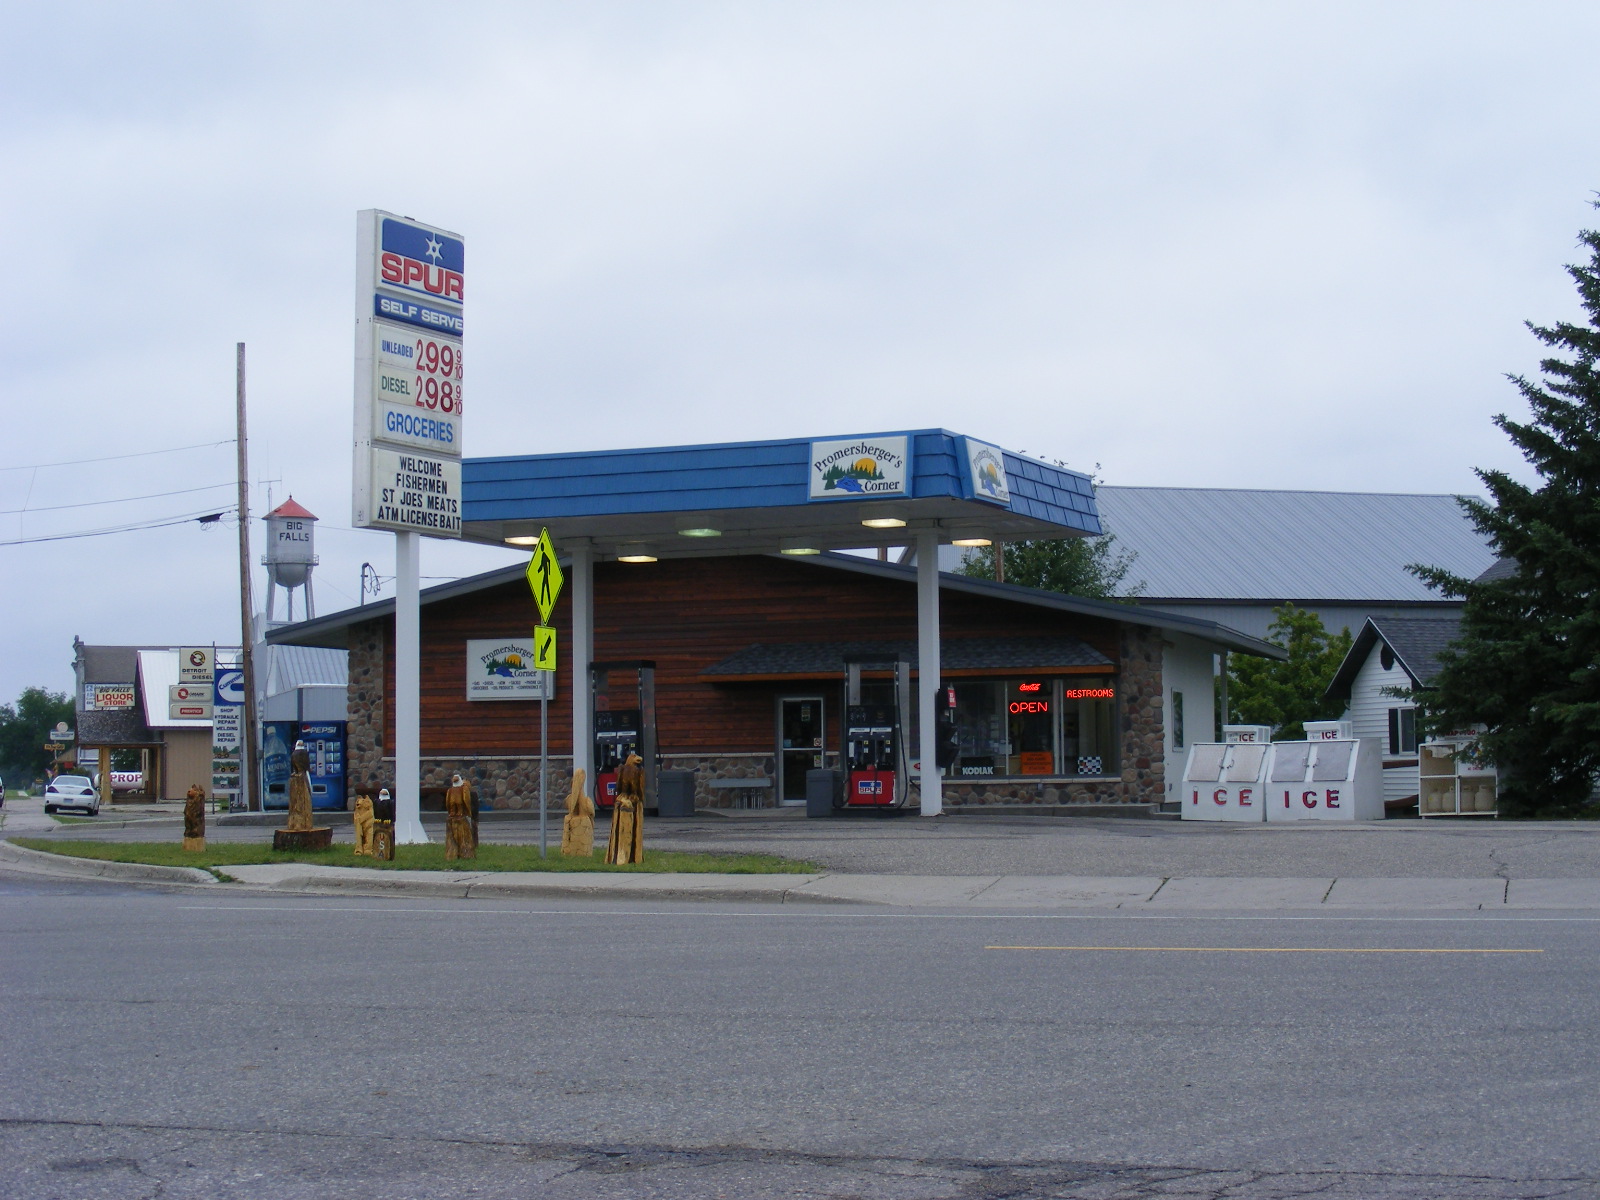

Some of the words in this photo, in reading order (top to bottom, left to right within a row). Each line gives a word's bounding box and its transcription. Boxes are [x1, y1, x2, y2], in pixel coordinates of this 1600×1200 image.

[381, 252, 464, 301] SPUR
[380, 299, 418, 317] SELF
[421, 309, 464, 330] SERVE
[381, 340, 414, 359] UNLEADED
[416, 339, 454, 377] 299
[381, 375, 411, 396] DIESEL
[415, 375, 454, 413] 298
[386, 411, 454, 443] GROCERIES
[399, 456, 442, 477] WELCOME
[814, 441, 903, 473] Promersberger's
[396, 473, 448, 494] FISHERMEN
[864, 480, 900, 492] Corner
[382, 488, 395, 503] ST
[400, 491, 423, 507] JOES
[427, 495, 458, 513] MEATS
[286, 521, 303, 530] BIG
[377, 505, 399, 521] ATM
[400, 508, 438, 527] LICENSE
[439, 514, 461, 531] BAIT
[279, 532, 310, 542] FALLS
[480, 643, 535, 664] Promersberger
[219, 672, 244, 690] Cummin
[513, 670, 538, 678] Corner
[96, 693, 134, 702] LIQUOR
[1066, 688, 1114, 698] RESTROOMS
[1009, 701, 1048, 713] OPEN
[1239, 733, 1255, 742] ICE
[1321, 730, 1337, 740] ICE
[962, 766, 993, 775] KODIAK
[1192, 788, 1253, 806] ICE
[1284, 788, 1340, 809] ICE
